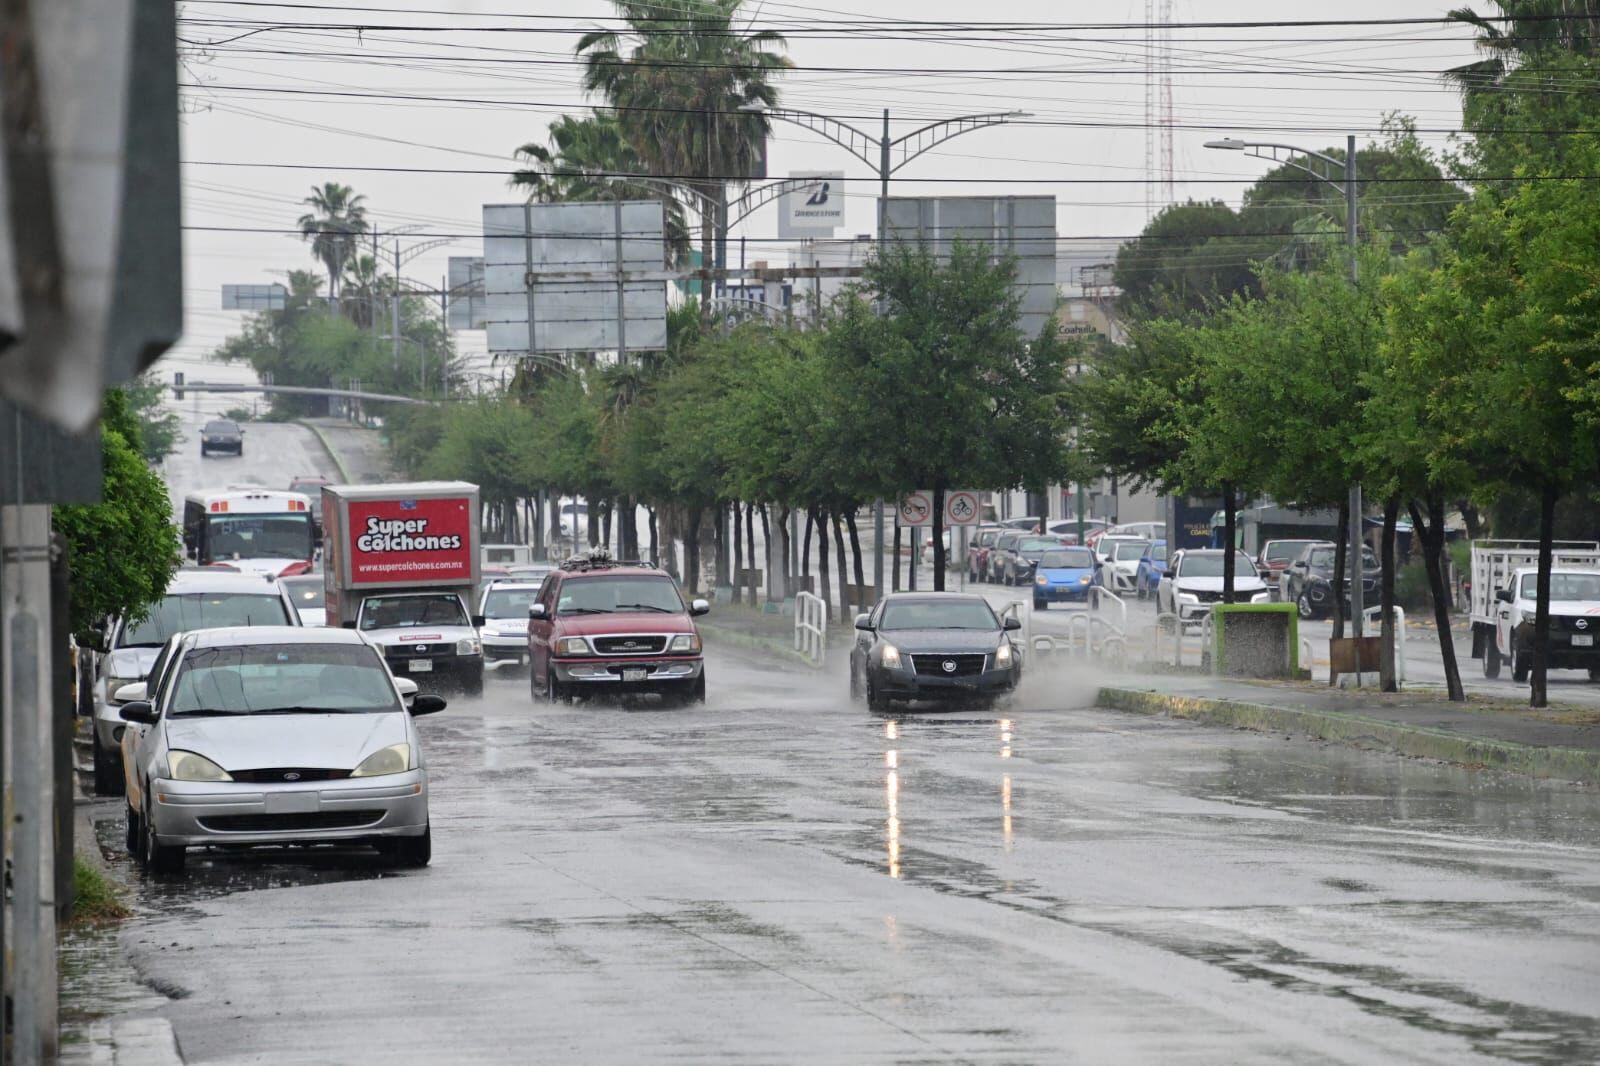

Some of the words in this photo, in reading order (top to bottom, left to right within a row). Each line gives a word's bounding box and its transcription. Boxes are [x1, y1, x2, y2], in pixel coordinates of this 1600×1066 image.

[366, 516, 428, 537] Super
[357, 533, 461, 552] Colchones
[358, 561, 463, 573] www.supercolchones.com.mx
